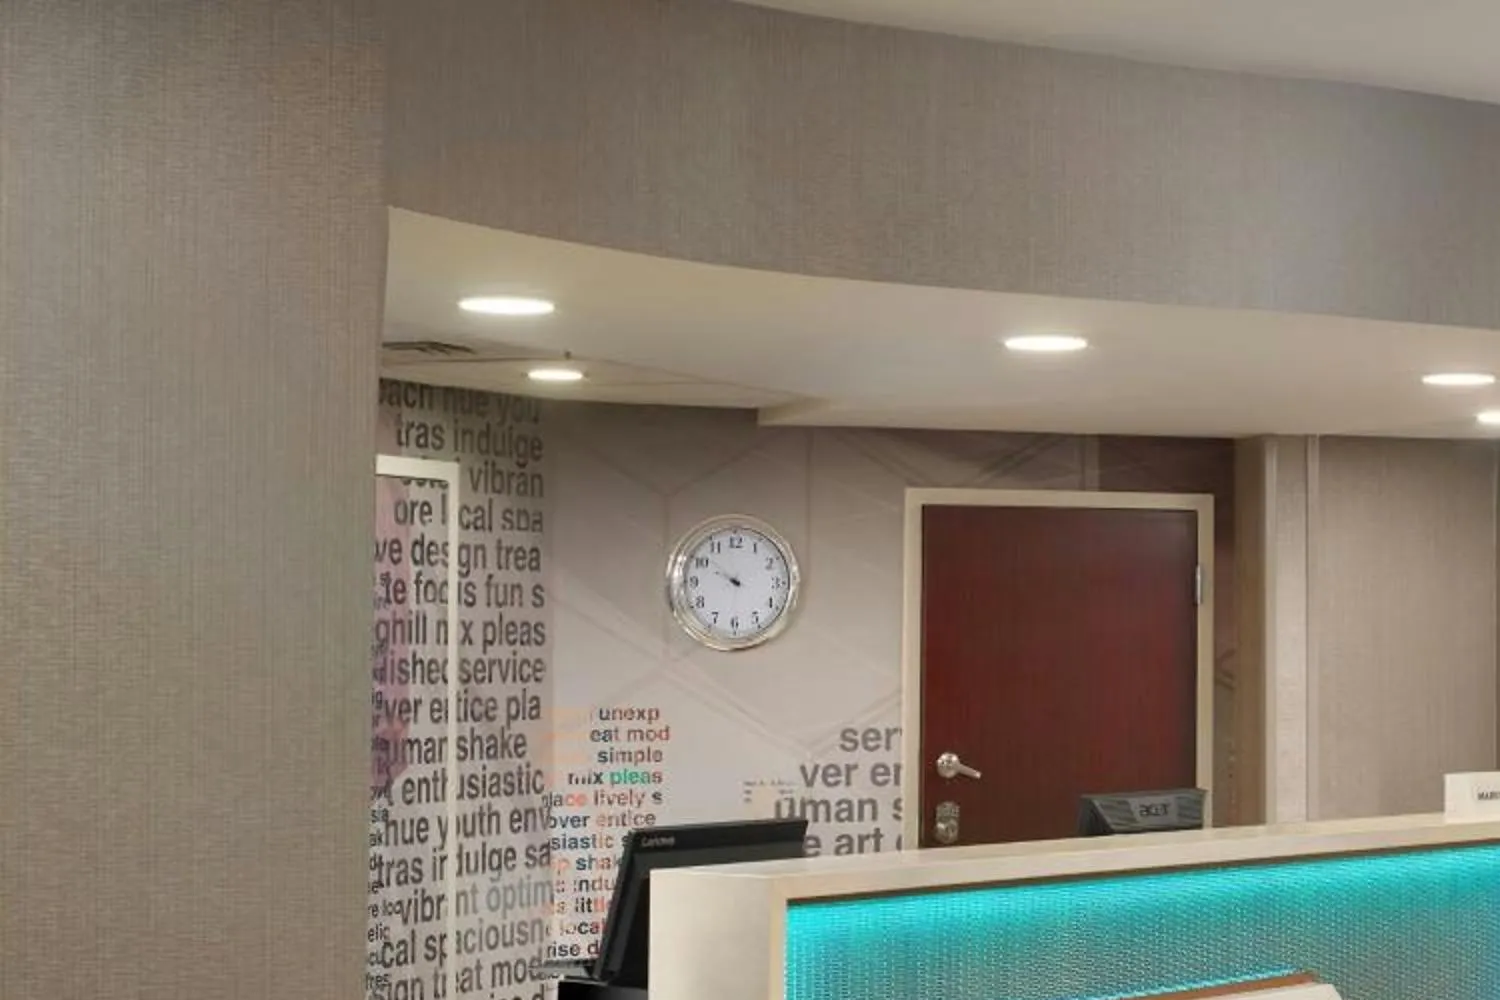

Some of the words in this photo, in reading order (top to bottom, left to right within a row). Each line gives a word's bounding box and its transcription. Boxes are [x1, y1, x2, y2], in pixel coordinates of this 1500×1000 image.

[396, 414, 446, 451] tras
[454, 417, 543, 468] indulge
[469, 459, 544, 498] vibran
[441, 493, 493, 532] lcal
[411, 531, 487, 579] desgn
[496, 539, 541, 573] trea
[729, 535, 744, 549] 12
[414, 570, 477, 608] focs
[485, 573, 523, 608] fun
[436, 617, 474, 646] mx
[482, 612, 546, 654] pleas
[458, 651, 546, 684] service
[505, 688, 541, 730] pla
[598, 706, 660, 724] unexp
[456, 727, 527, 762] shake
[627, 725, 671, 742] mod
[597, 746, 663, 766] simple
[609, 767, 663, 787] pleas
[800, 762, 859, 788] ver
[385, 816, 429, 847] hue
[437, 804, 501, 850] yuth
[595, 809, 657, 828] entice
[834, 827, 884, 857] art
[377, 855, 423, 887] tras
[400, 882, 479, 925] vibrnt
[423, 917, 544, 968] spciousn
[433, 958, 483, 1000] trat
